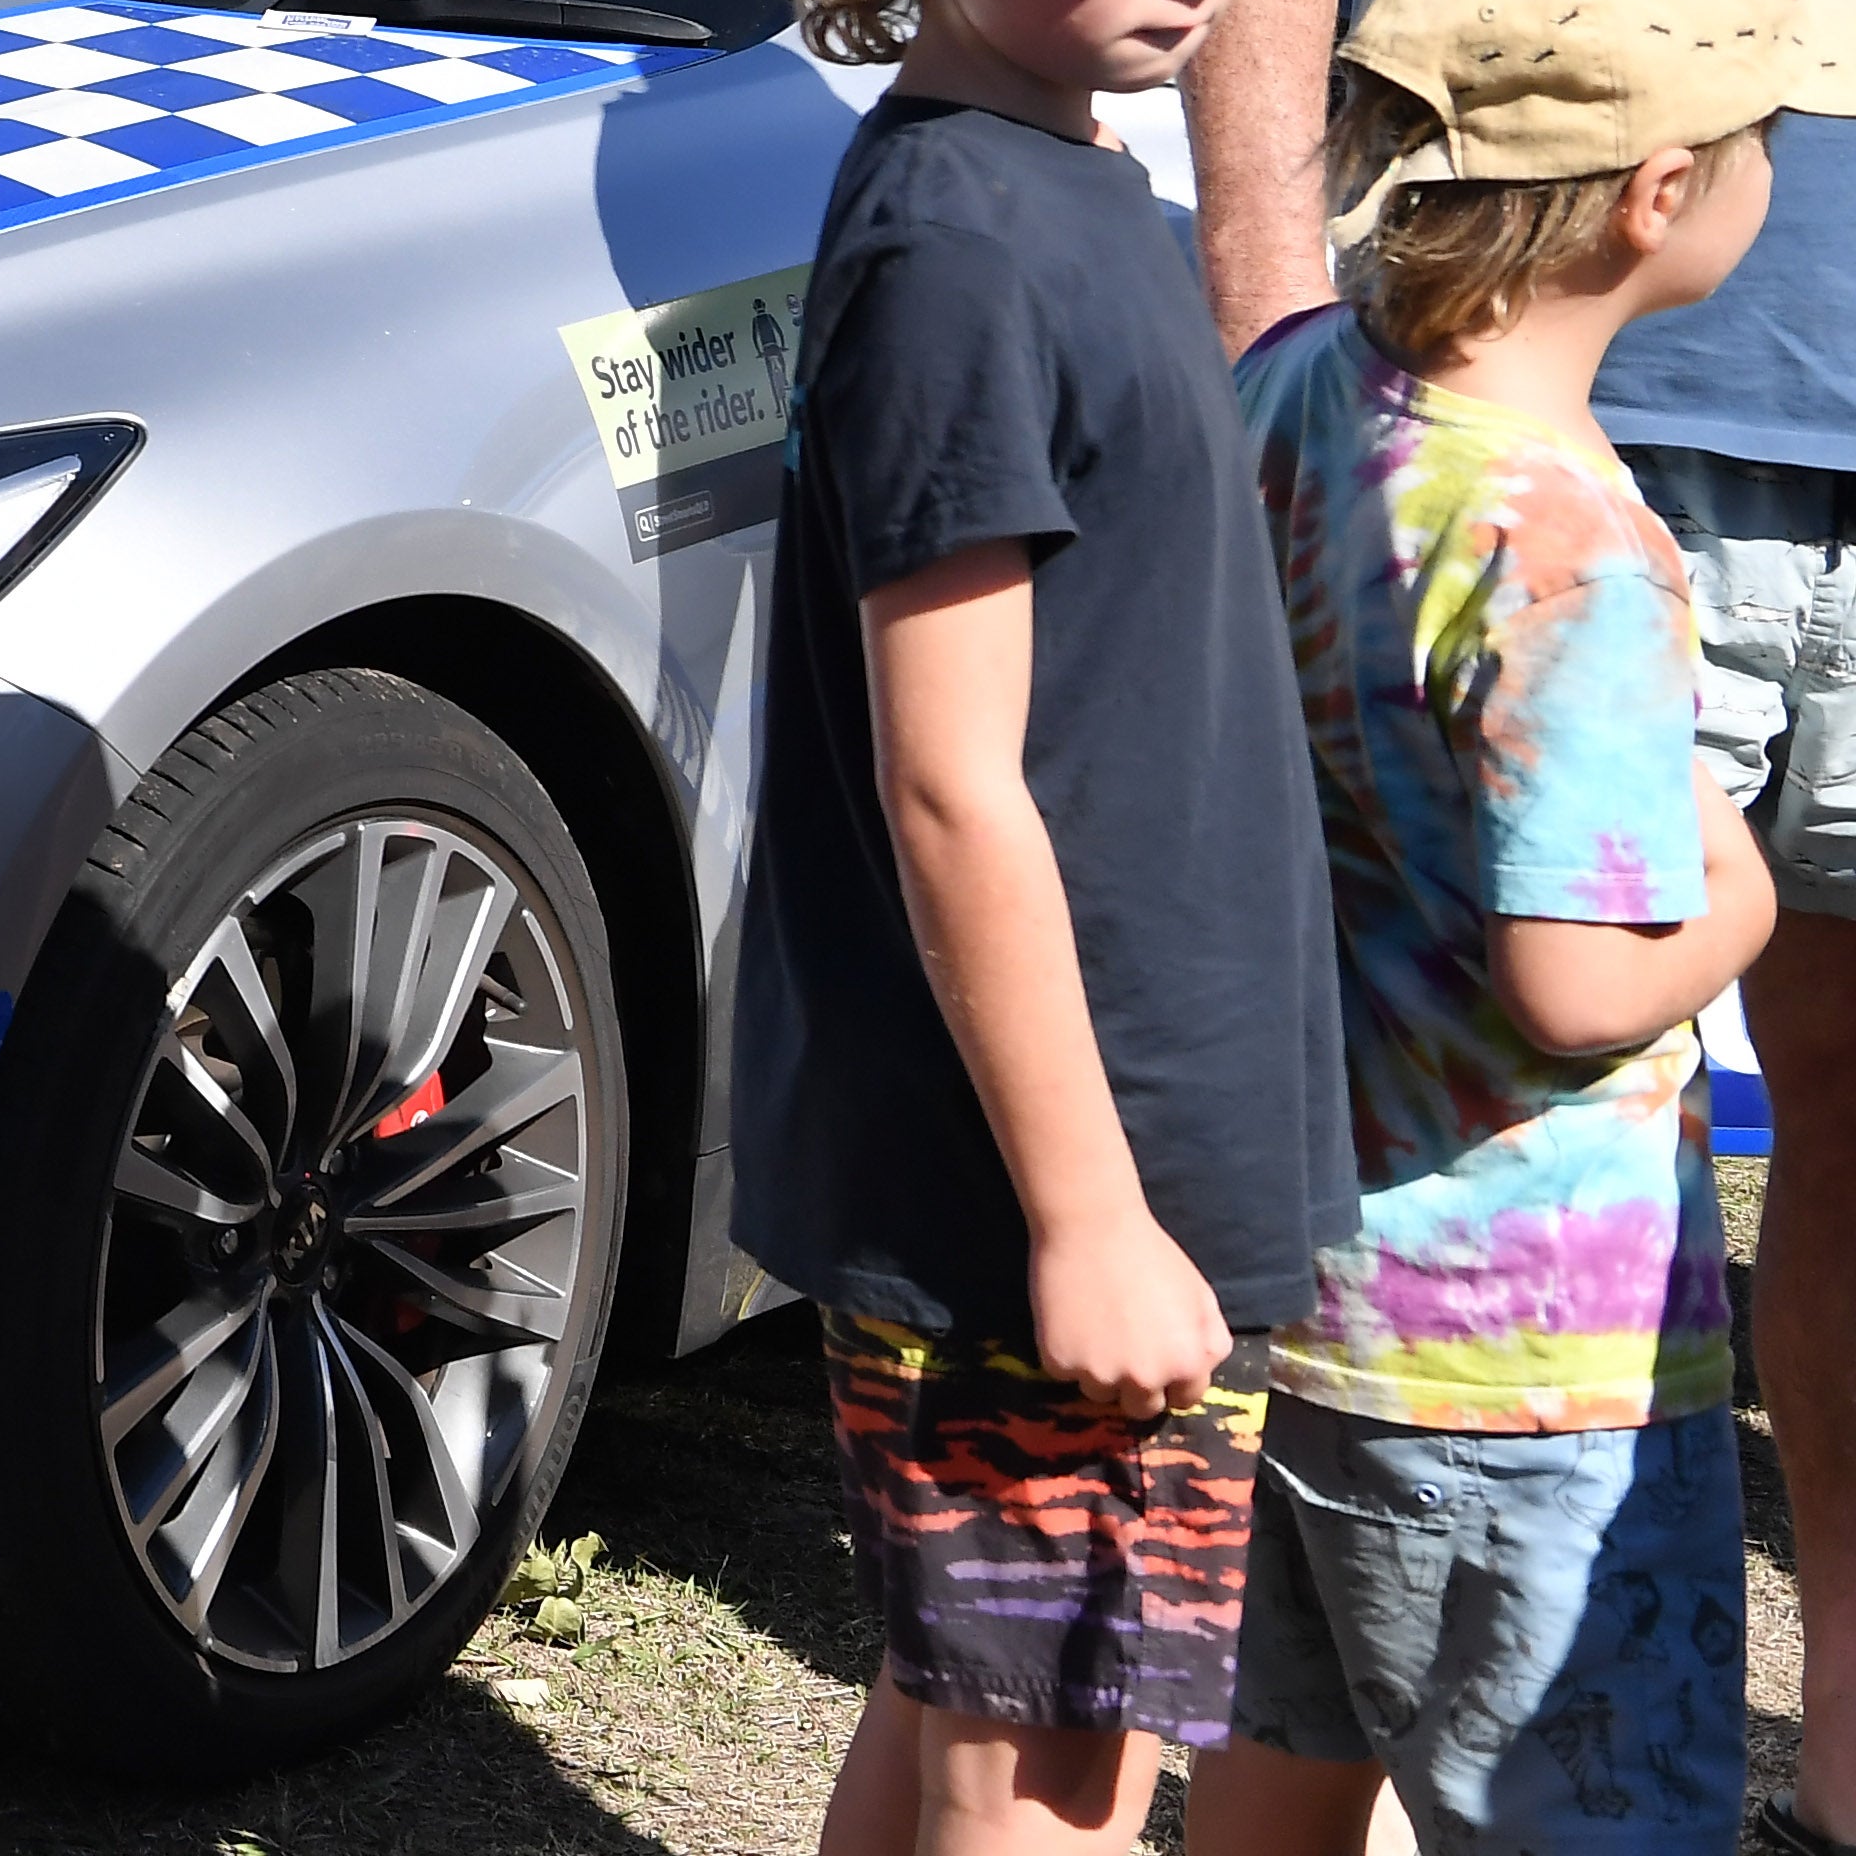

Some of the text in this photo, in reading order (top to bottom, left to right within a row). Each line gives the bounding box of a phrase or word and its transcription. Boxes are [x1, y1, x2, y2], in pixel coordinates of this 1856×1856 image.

[591, 326, 735, 400] Stay wider
[615, 384, 765, 458] of the rider.
[279, 1201, 327, 1271] KIA
